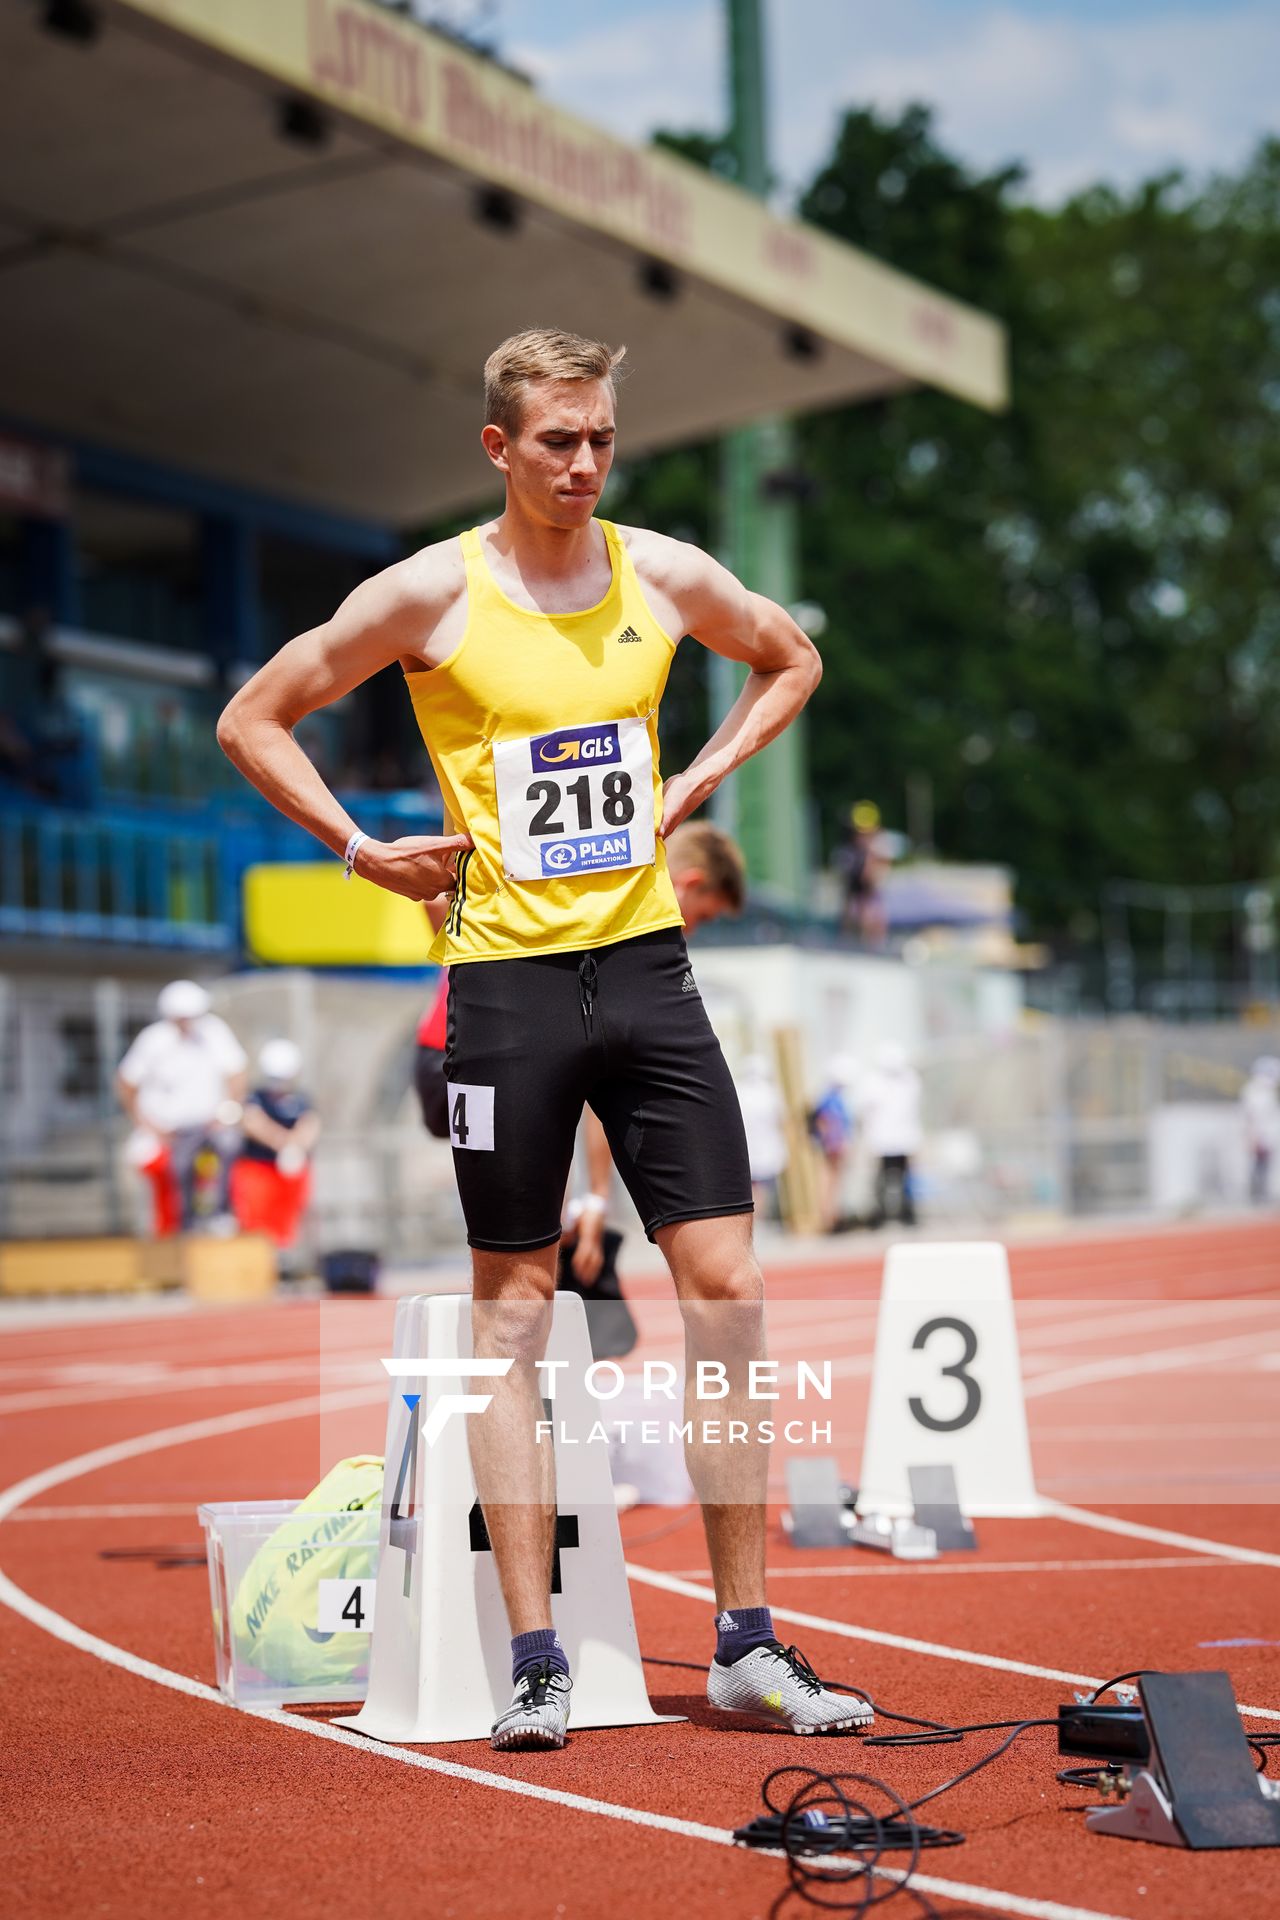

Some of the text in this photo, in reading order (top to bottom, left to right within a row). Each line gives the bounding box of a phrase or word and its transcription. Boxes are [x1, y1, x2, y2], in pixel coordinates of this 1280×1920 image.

[618, 635, 642, 643] adidas
[581, 736, 614, 759] GLS
[526, 771, 635, 837] 218
[580, 837, 627, 858] PLAN
[581, 855, 628, 866] INTERNATIONAL
[452, 1092, 469, 1145] 4
[908, 1317, 982, 1433] 3
[246, 1498, 363, 1639] NIKE RACING
[341, 1585, 365, 1629] 4
